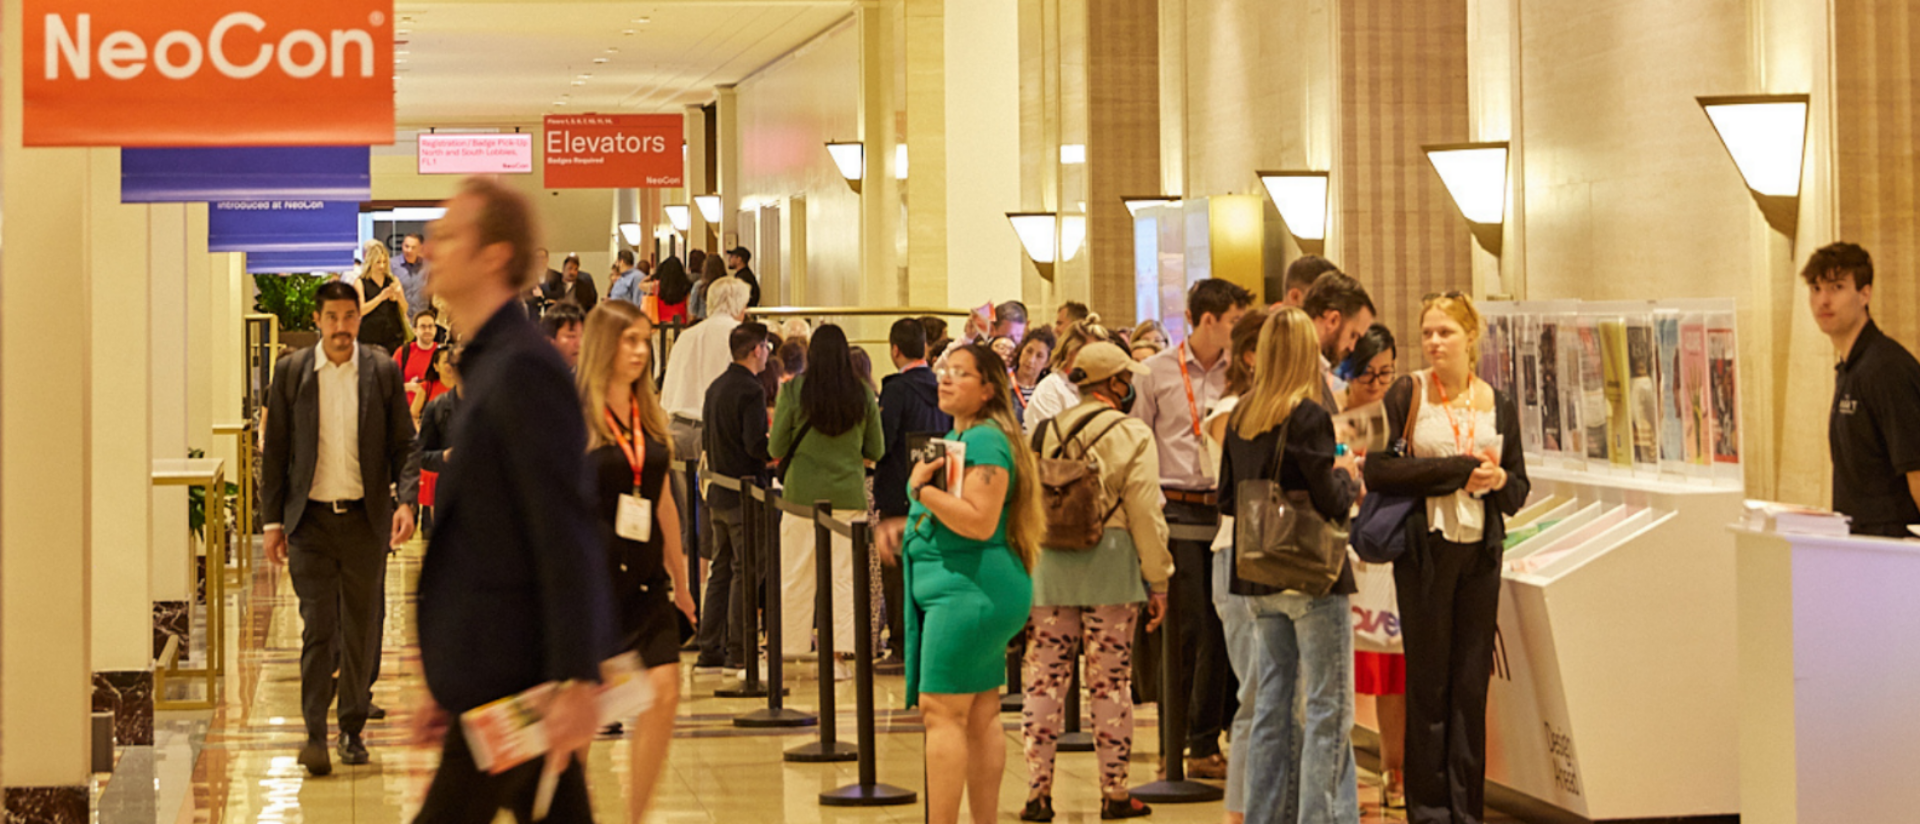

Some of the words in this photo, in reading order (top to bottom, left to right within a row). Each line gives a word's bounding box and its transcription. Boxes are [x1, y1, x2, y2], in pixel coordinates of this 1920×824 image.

[421, 140, 467, 149] Registration
[472, 140, 496, 149] Badge
[547, 130, 665, 153] Elevators
[547, 157, 572, 165] Badges
[573, 157, 605, 165] Required
[646, 176, 680, 185] NeoCon
[284, 201, 324, 210] NeoCon
[1543, 720, 1572, 767] Design
